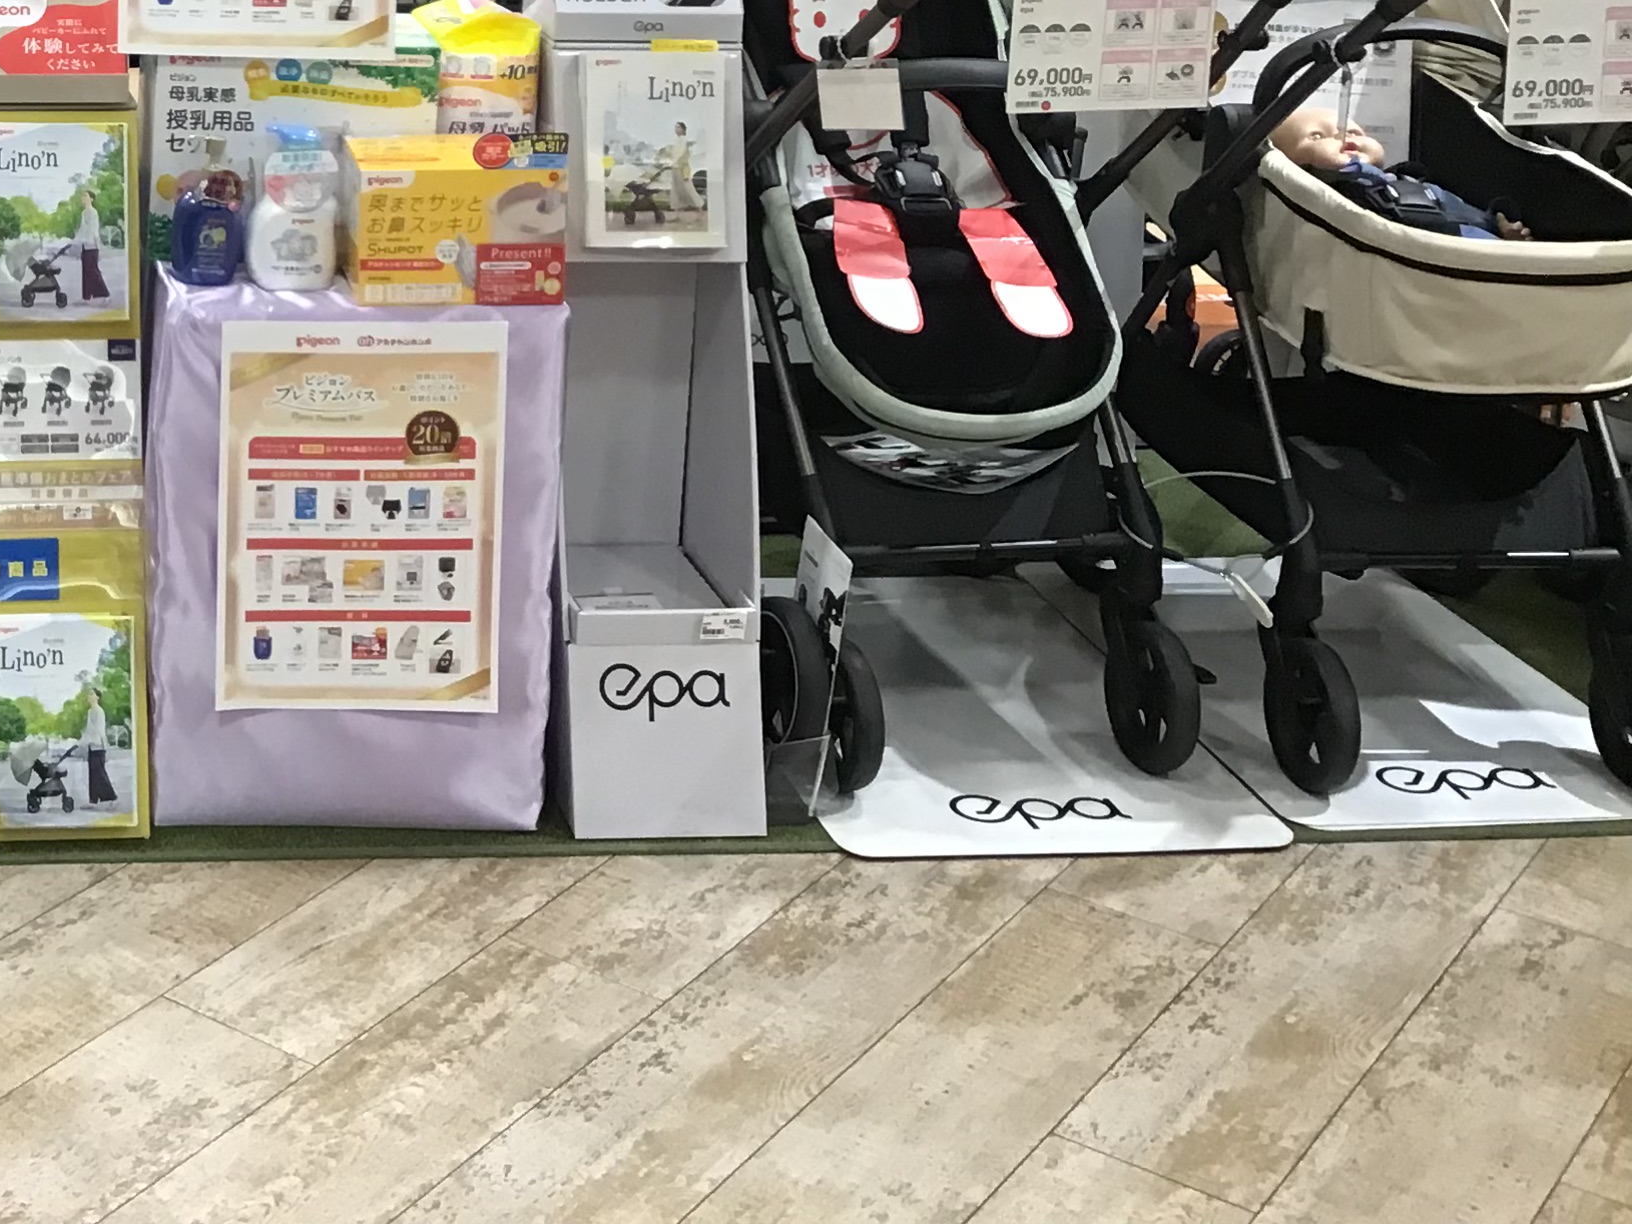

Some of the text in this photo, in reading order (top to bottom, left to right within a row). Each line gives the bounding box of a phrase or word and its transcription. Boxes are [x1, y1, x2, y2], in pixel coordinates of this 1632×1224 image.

[633, 20, 664, 34] epa
[46, 57, 96, 70] ください
[1014, 67, 1093, 86] 69,000円
[169, 86, 236, 103] 母乳実感
[1512, 78, 1594, 98] 69,000円
[166, 109, 255, 132] 授乳用品
[367, 175, 403, 186] pigeon
[368, 194, 483, 212] 奥までサッと
[367, 216, 483, 234] お鼻スッキリ
[296, 335, 340, 347] pigeon
[304, 374, 349, 386] ピジョン
[275, 386, 376, 403] プレミアムパス
[599, 663, 731, 722] epa
[1376, 765, 1557, 801] epa
[949, 793, 1133, 830] epa
